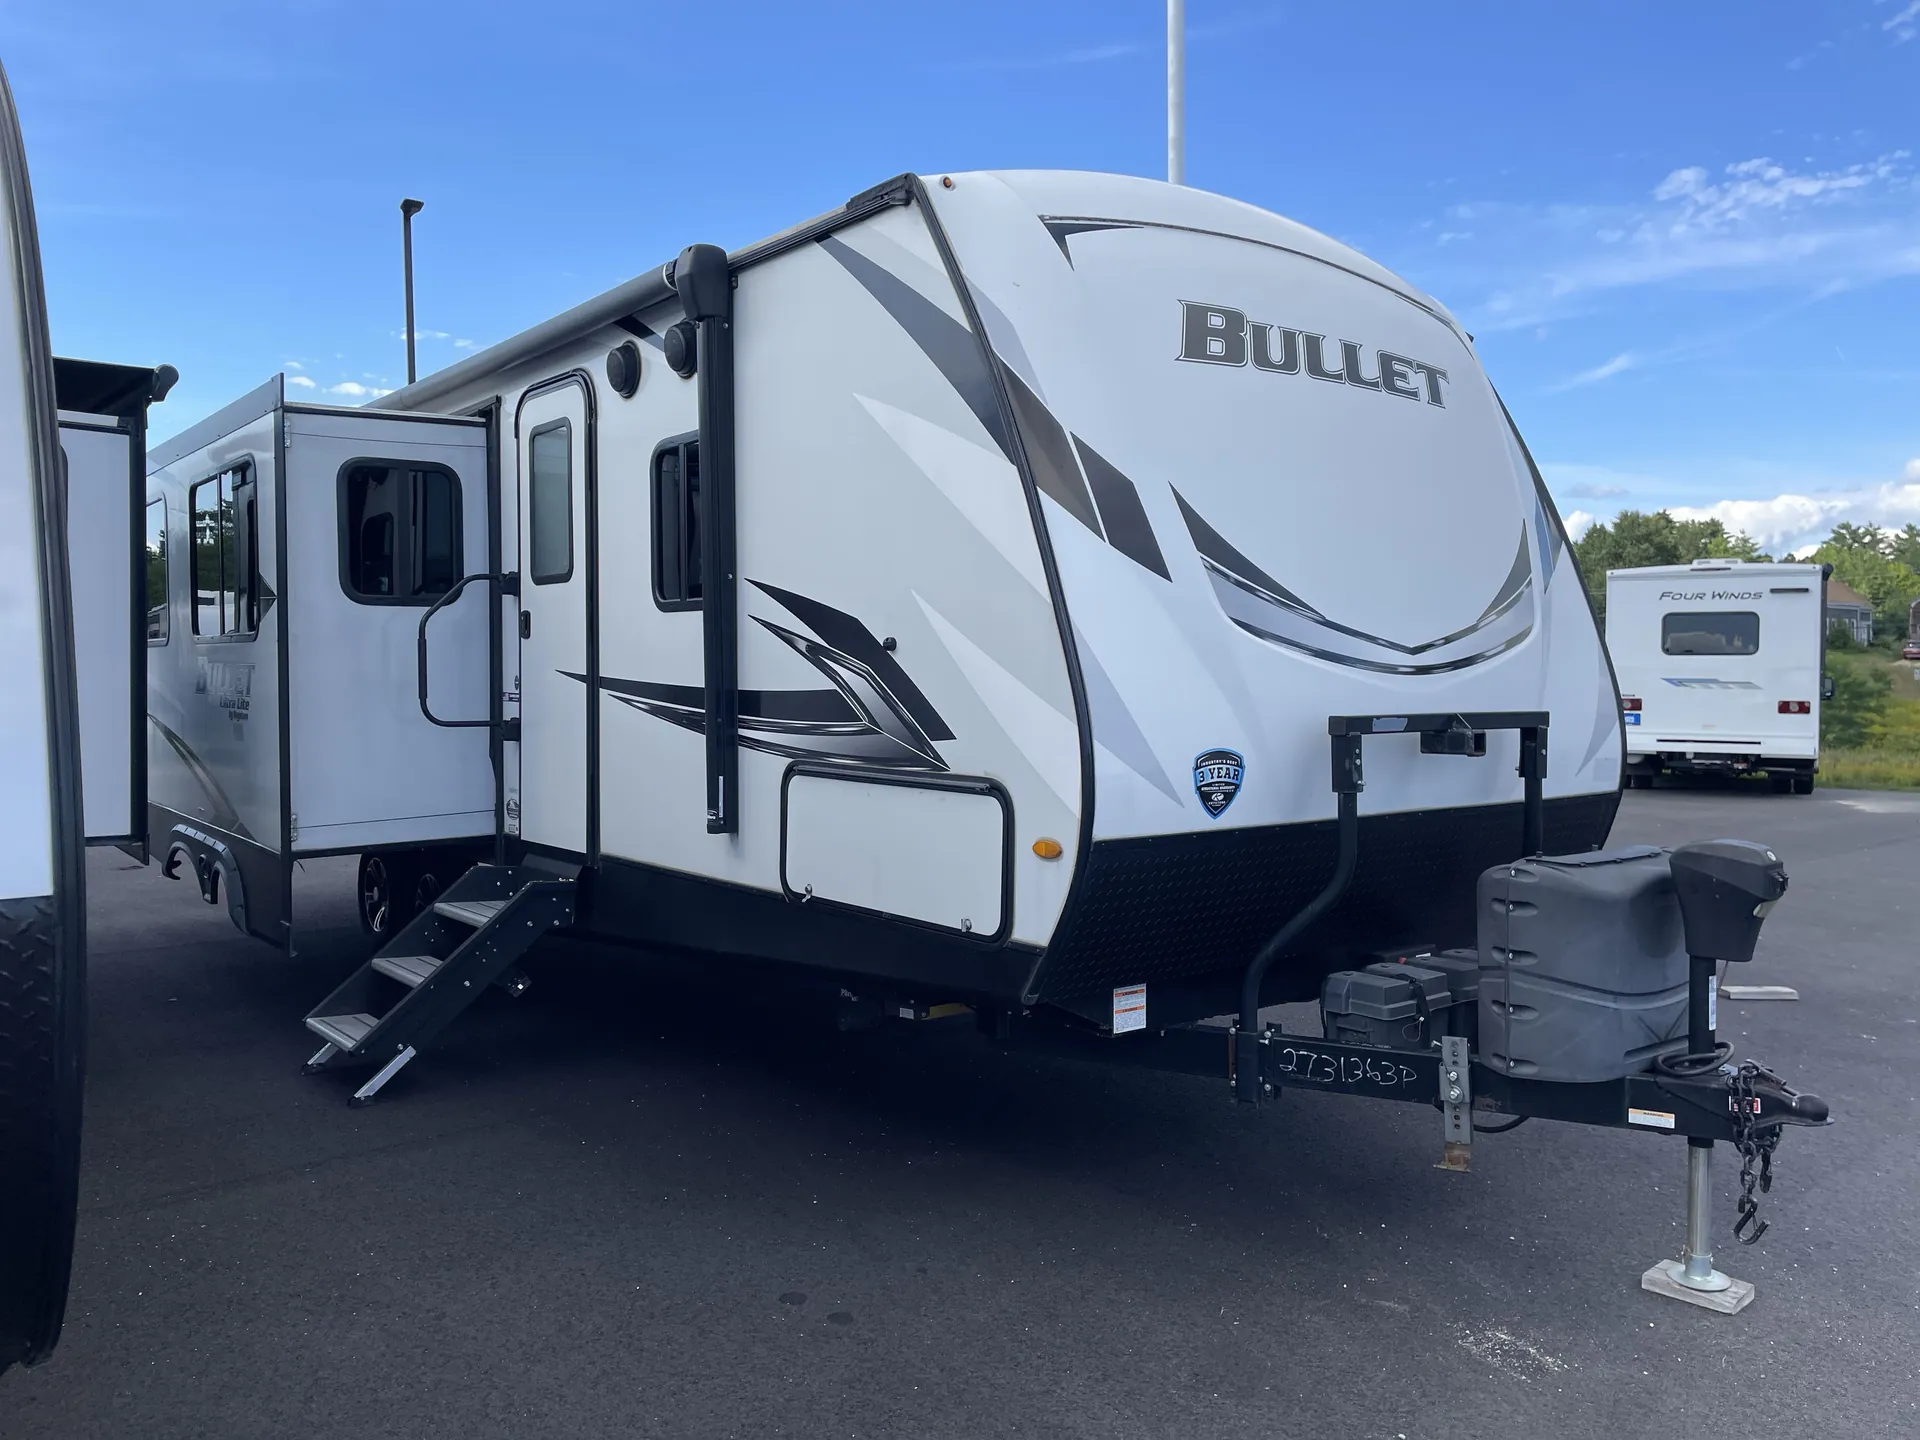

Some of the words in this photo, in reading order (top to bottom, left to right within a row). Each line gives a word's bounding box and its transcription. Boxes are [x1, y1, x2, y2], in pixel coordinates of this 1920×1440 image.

[1174, 299, 1450, 409] BULLET
[1659, 591, 1706, 601] FOUR
[1711, 590, 1763, 600] WINDS
[237, 697, 250, 711] Lite
[1198, 770, 1205, 783] 3
[1208, 767, 1240, 781] YEAR
